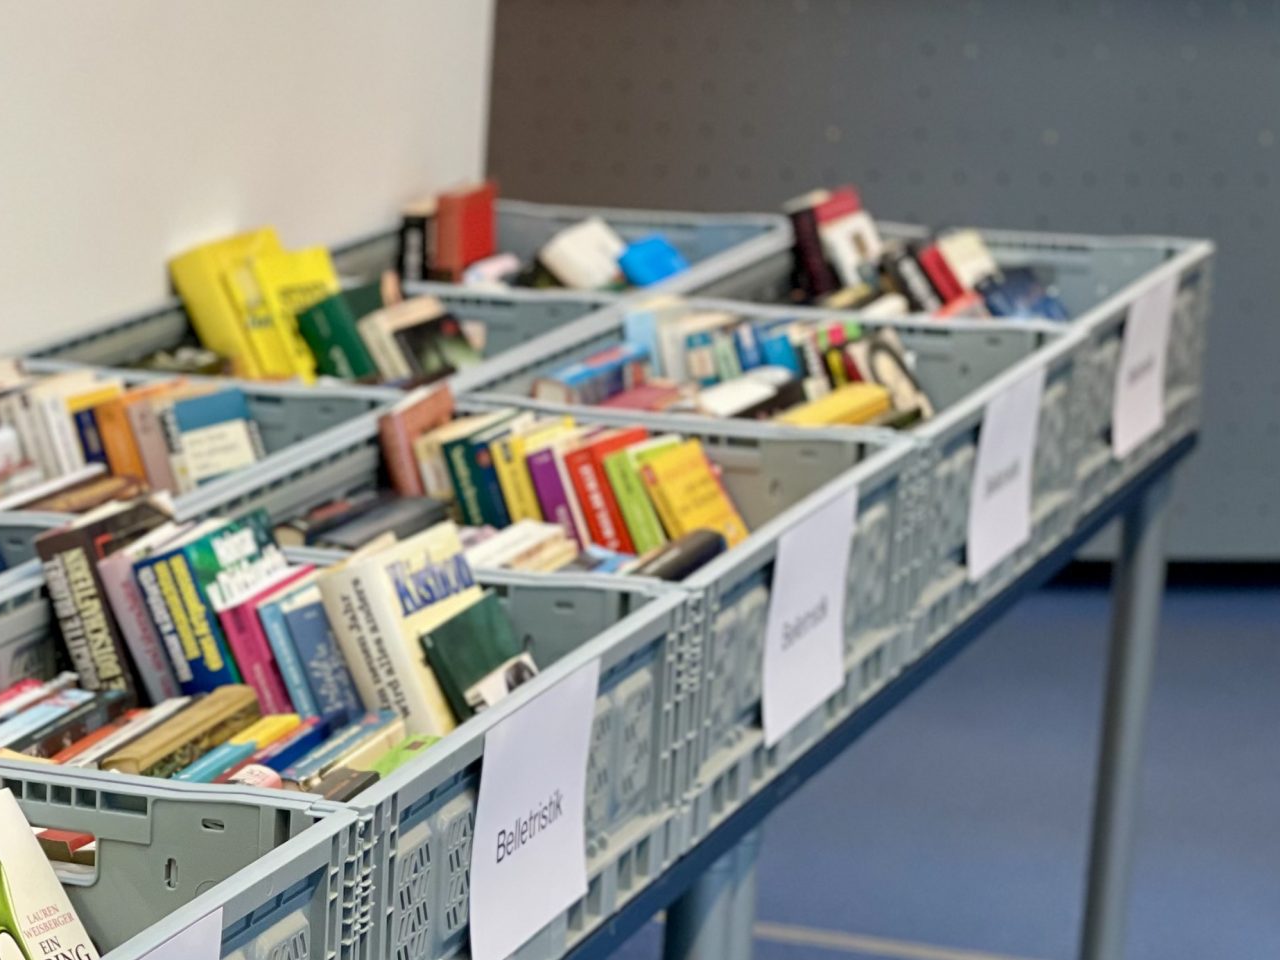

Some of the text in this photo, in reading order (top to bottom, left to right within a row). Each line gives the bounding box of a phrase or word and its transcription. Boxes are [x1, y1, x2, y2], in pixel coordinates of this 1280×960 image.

[496, 788, 563, 864] Belletristik
[23, 913, 75, 939] WEISBERGER
[26, 903, 60, 925] LAUREN
[38, 936, 62, 955] EIN
